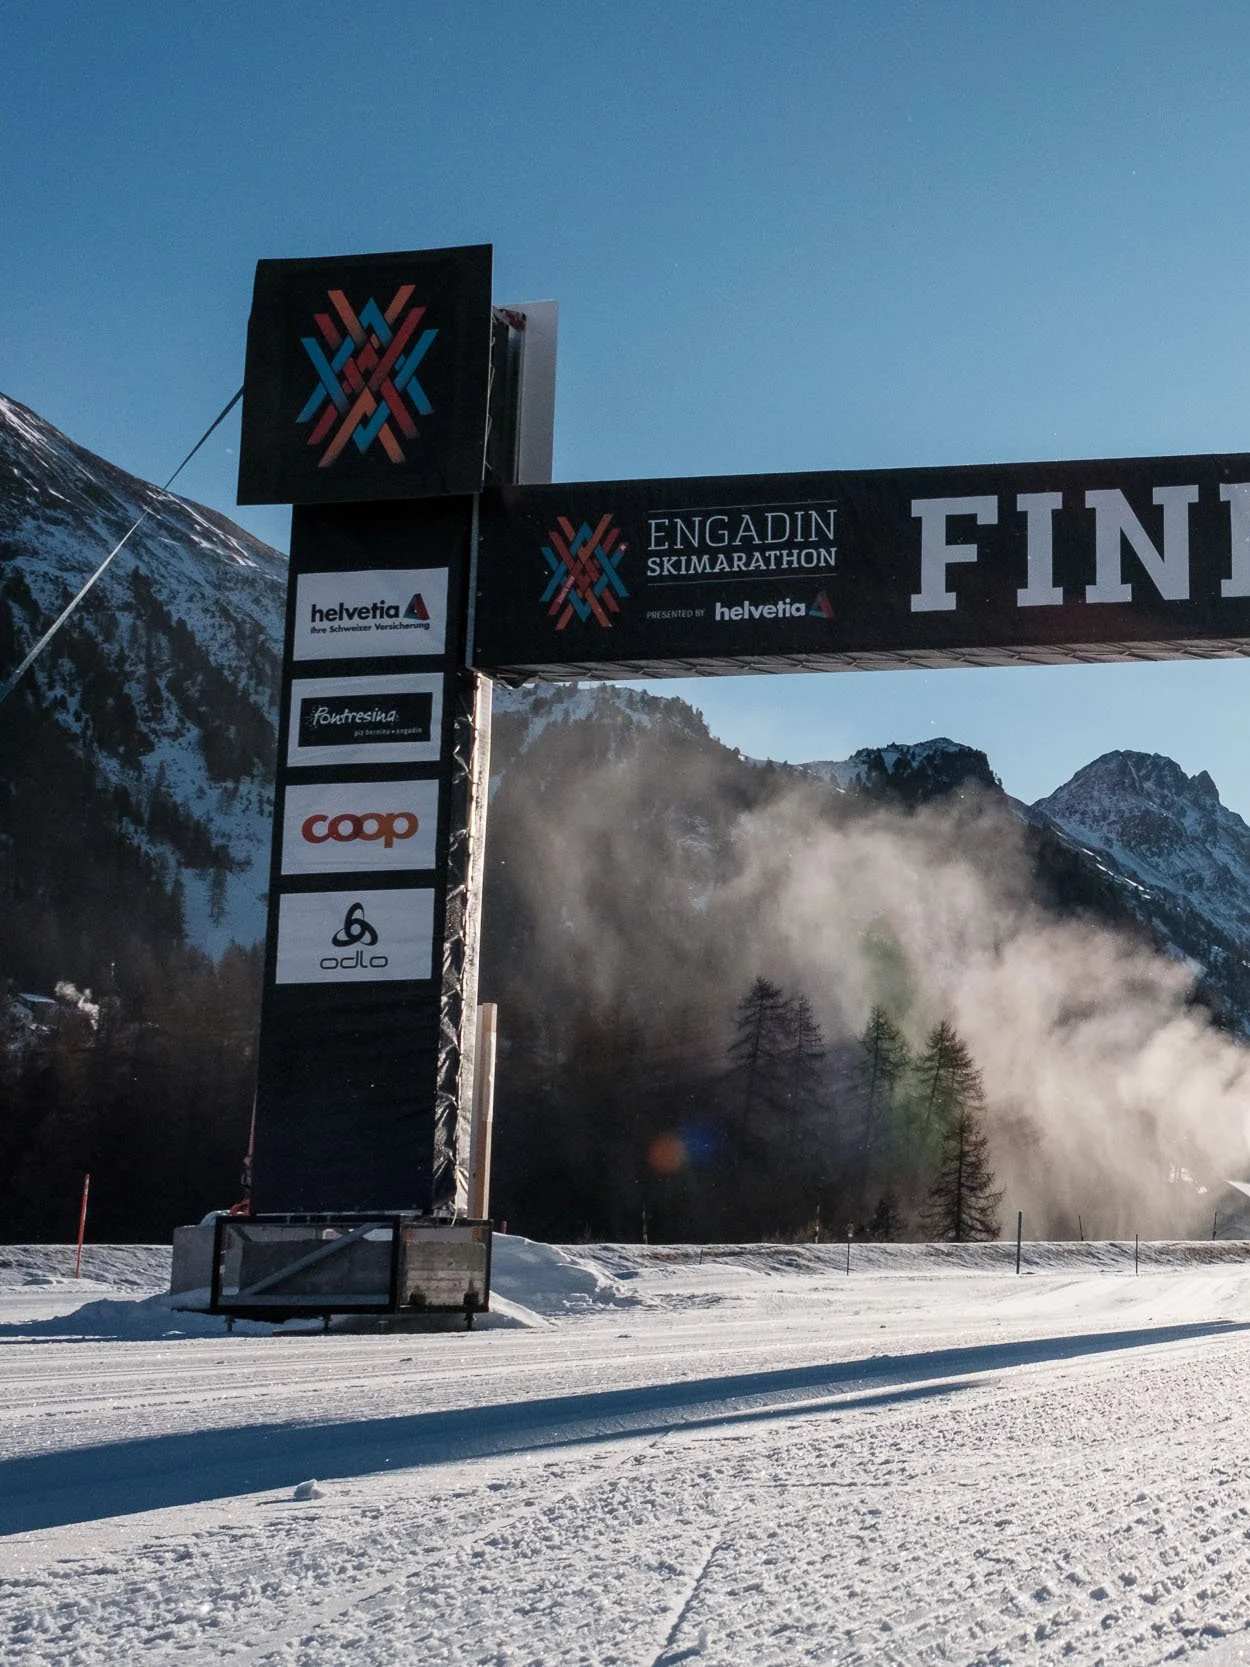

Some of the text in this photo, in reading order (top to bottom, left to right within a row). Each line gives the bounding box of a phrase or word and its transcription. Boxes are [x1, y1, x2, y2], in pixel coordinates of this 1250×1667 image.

[648, 510, 837, 550] ENGADIN
[647, 548, 837, 576] SKIMARATHON
[311, 600, 400, 623] helvetia
[647, 598, 806, 621] PRESENTED BY helvetia
[310, 622, 430, 634] Ihre Schweizer Versicherung
[313, 707, 396, 726] Pontresina
[301, 812, 419, 848] coop
[320, 950, 388, 969] odlo
